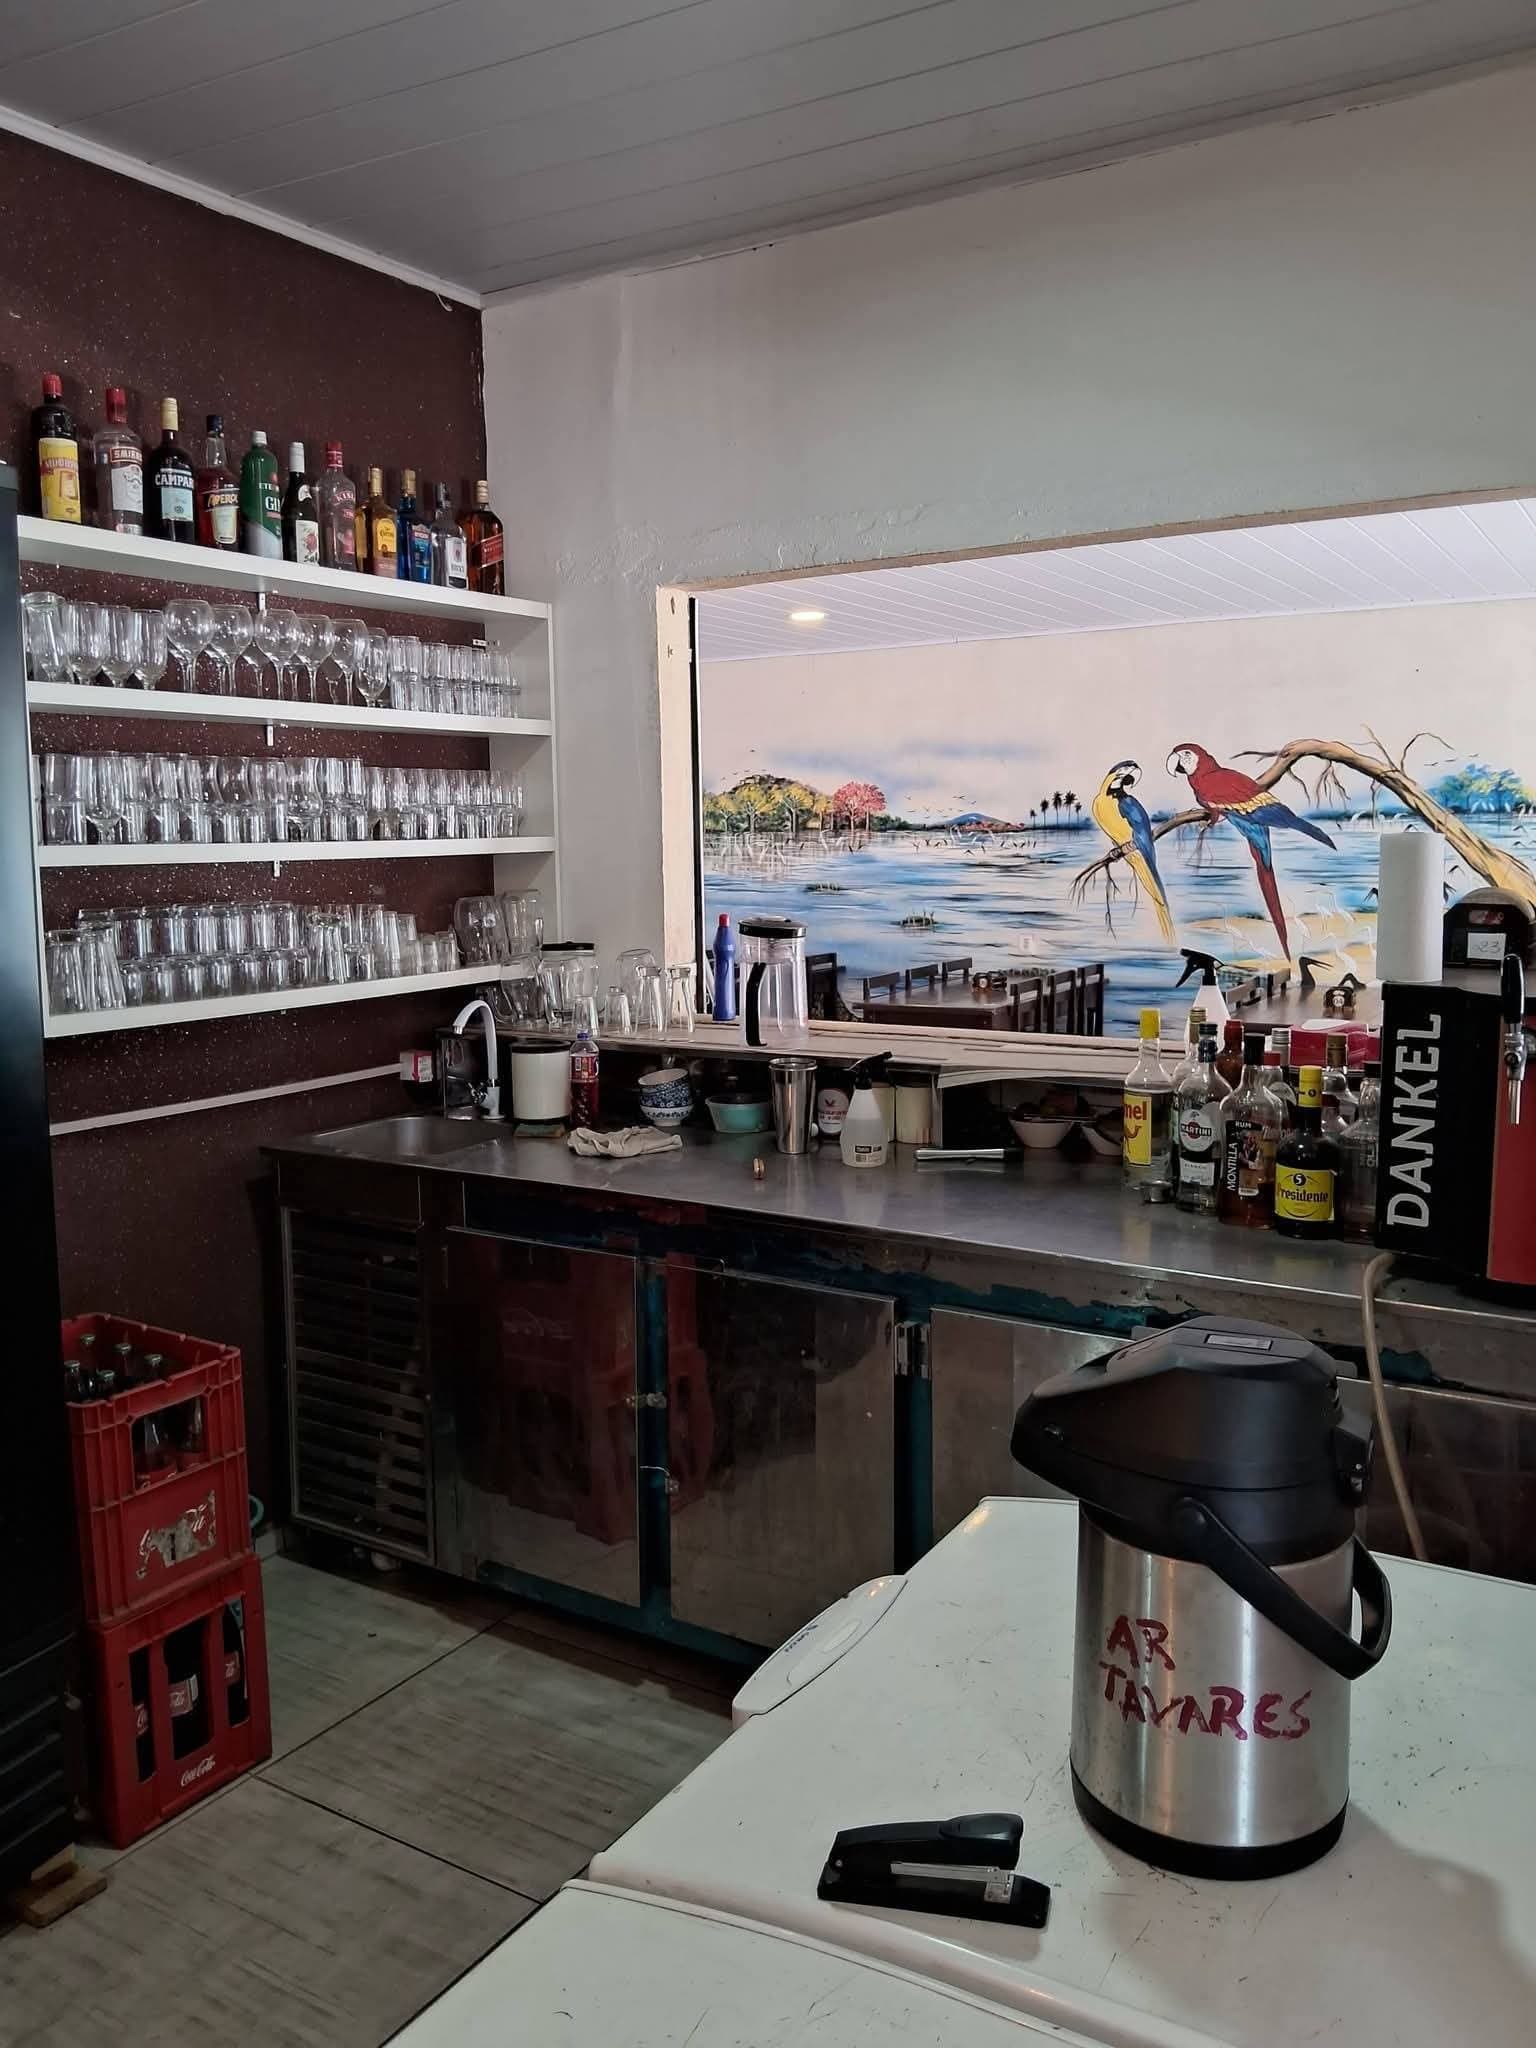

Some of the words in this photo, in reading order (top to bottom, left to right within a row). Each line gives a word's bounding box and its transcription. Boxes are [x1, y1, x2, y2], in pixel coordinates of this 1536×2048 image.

[1181, 1123, 1212, 1137] MARTINI
[1387, 1013, 1442, 1227] DANKEL
[1226, 1142, 1239, 1191] MONTILLA
[1107, 1615, 1176, 1671] AR
[1099, 1661, 1312, 1741] TAVARES
